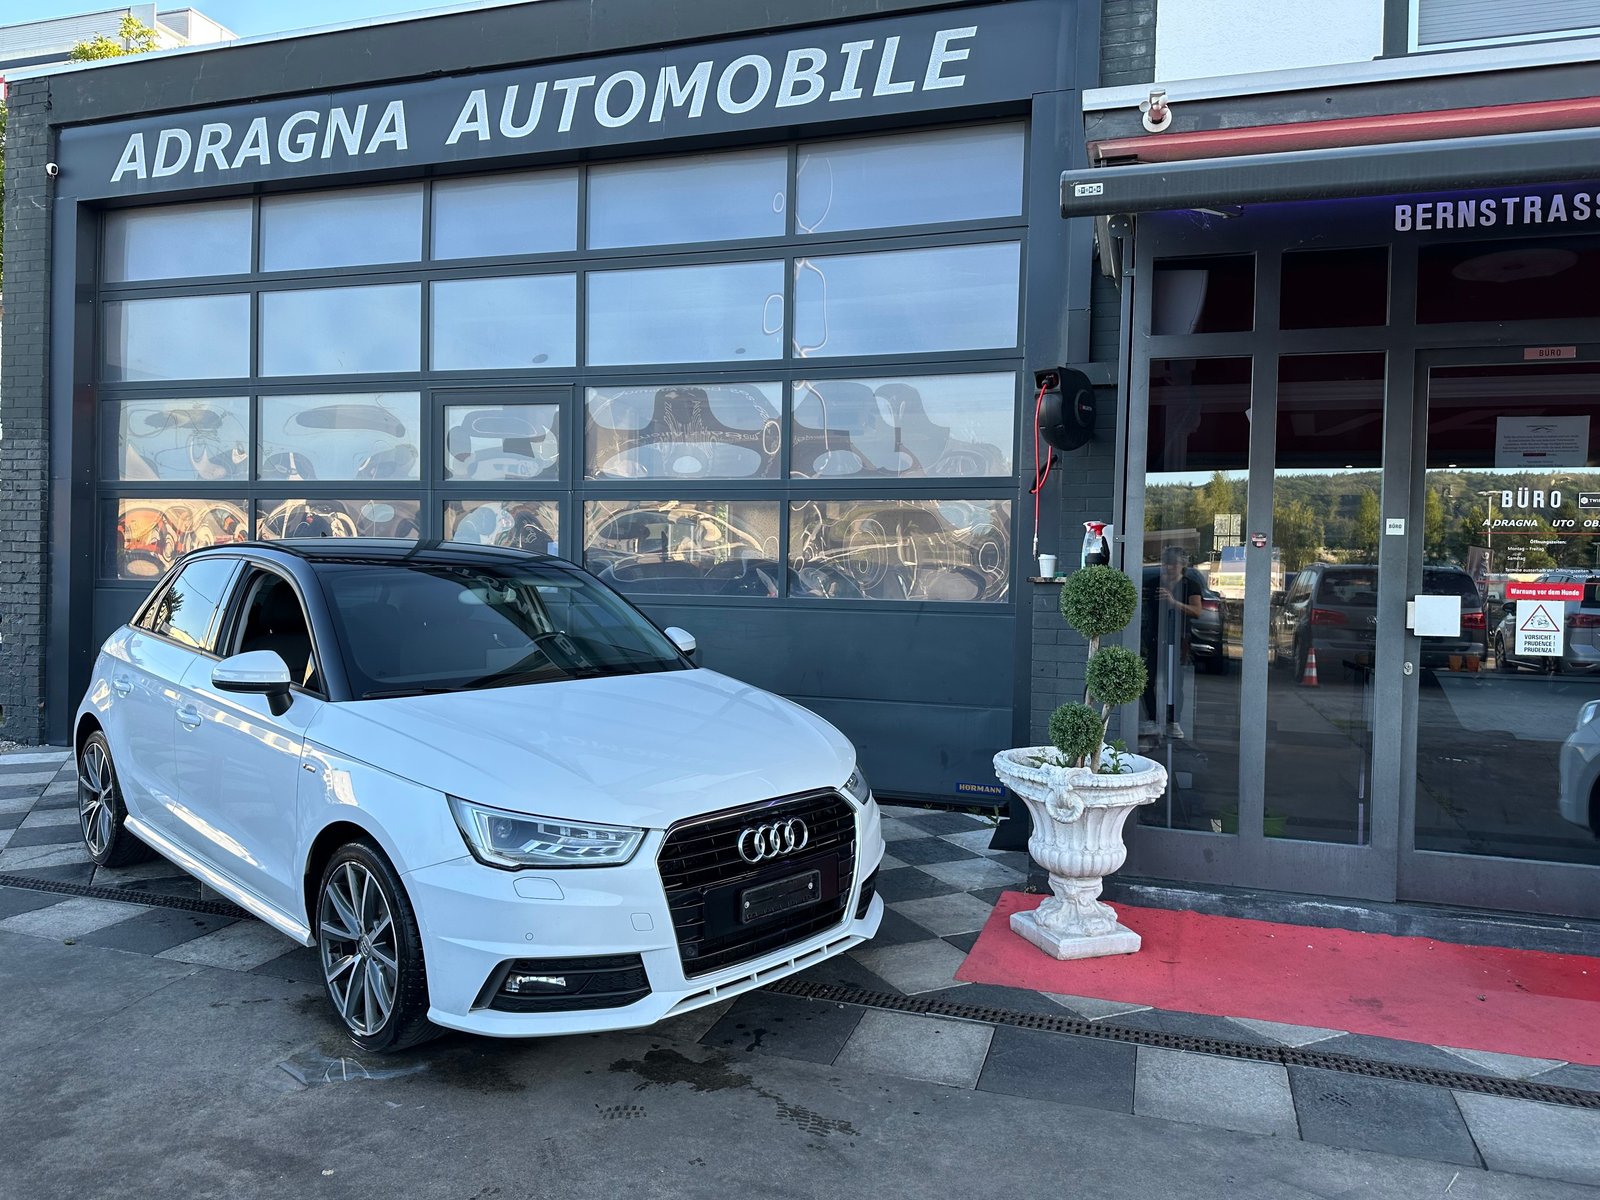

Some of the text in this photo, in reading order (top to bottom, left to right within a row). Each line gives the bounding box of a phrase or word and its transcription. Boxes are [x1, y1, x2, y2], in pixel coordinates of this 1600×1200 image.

[111, 25, 978, 183] ADRAGNA AUTOMOBILE
[1394, 192, 1600, 232] BERNSTRAS
[1501, 487, 1562, 508] BÜRO
[1510, 587, 1536, 596] Warnung
